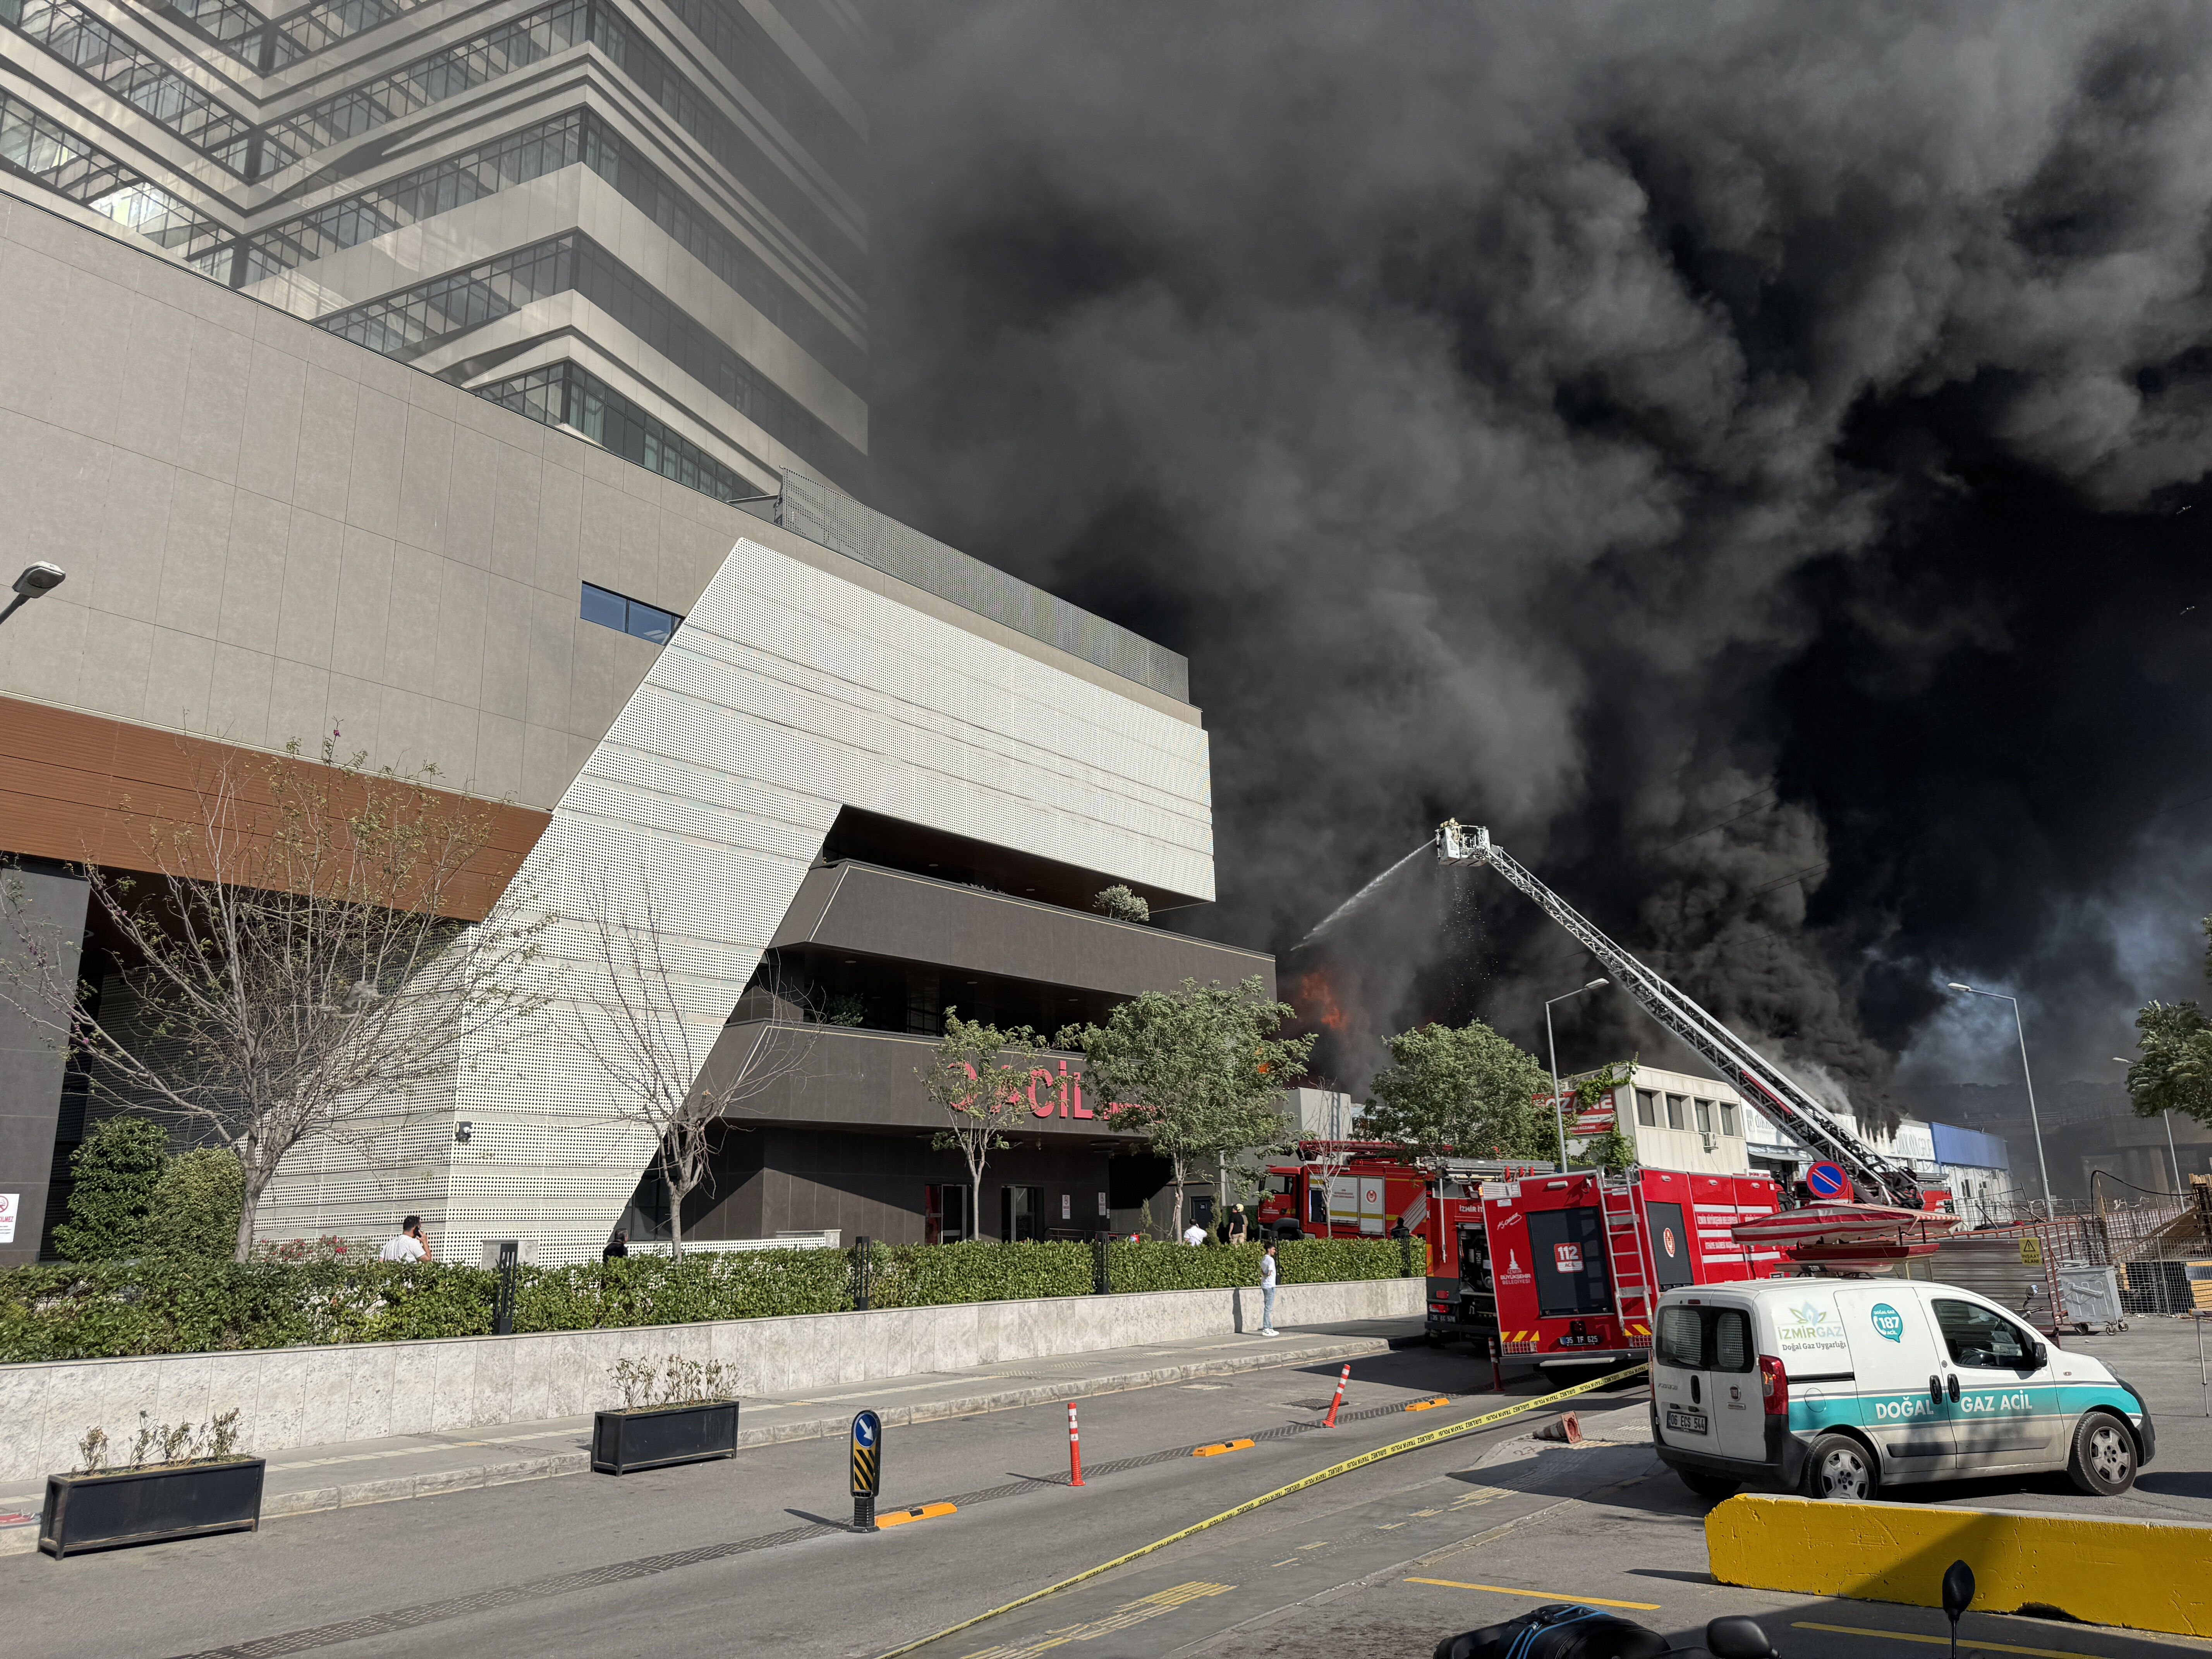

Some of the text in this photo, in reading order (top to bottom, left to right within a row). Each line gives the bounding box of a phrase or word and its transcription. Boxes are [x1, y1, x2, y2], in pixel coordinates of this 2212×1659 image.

[1558, 1245, 1579, 1260] 112
[1878, 1316, 1899, 1329] 187
[1777, 1326, 1844, 1340] İZMİRGAZ
[1782, 1343, 1802, 1352] Doğal
[1815, 1341, 1846, 1350] Uygarlığı
[1875, 1390, 2033, 1419] DOĞAL GAZ ACİL
[1671, 1414, 1704, 1430] 06 ECS 544
